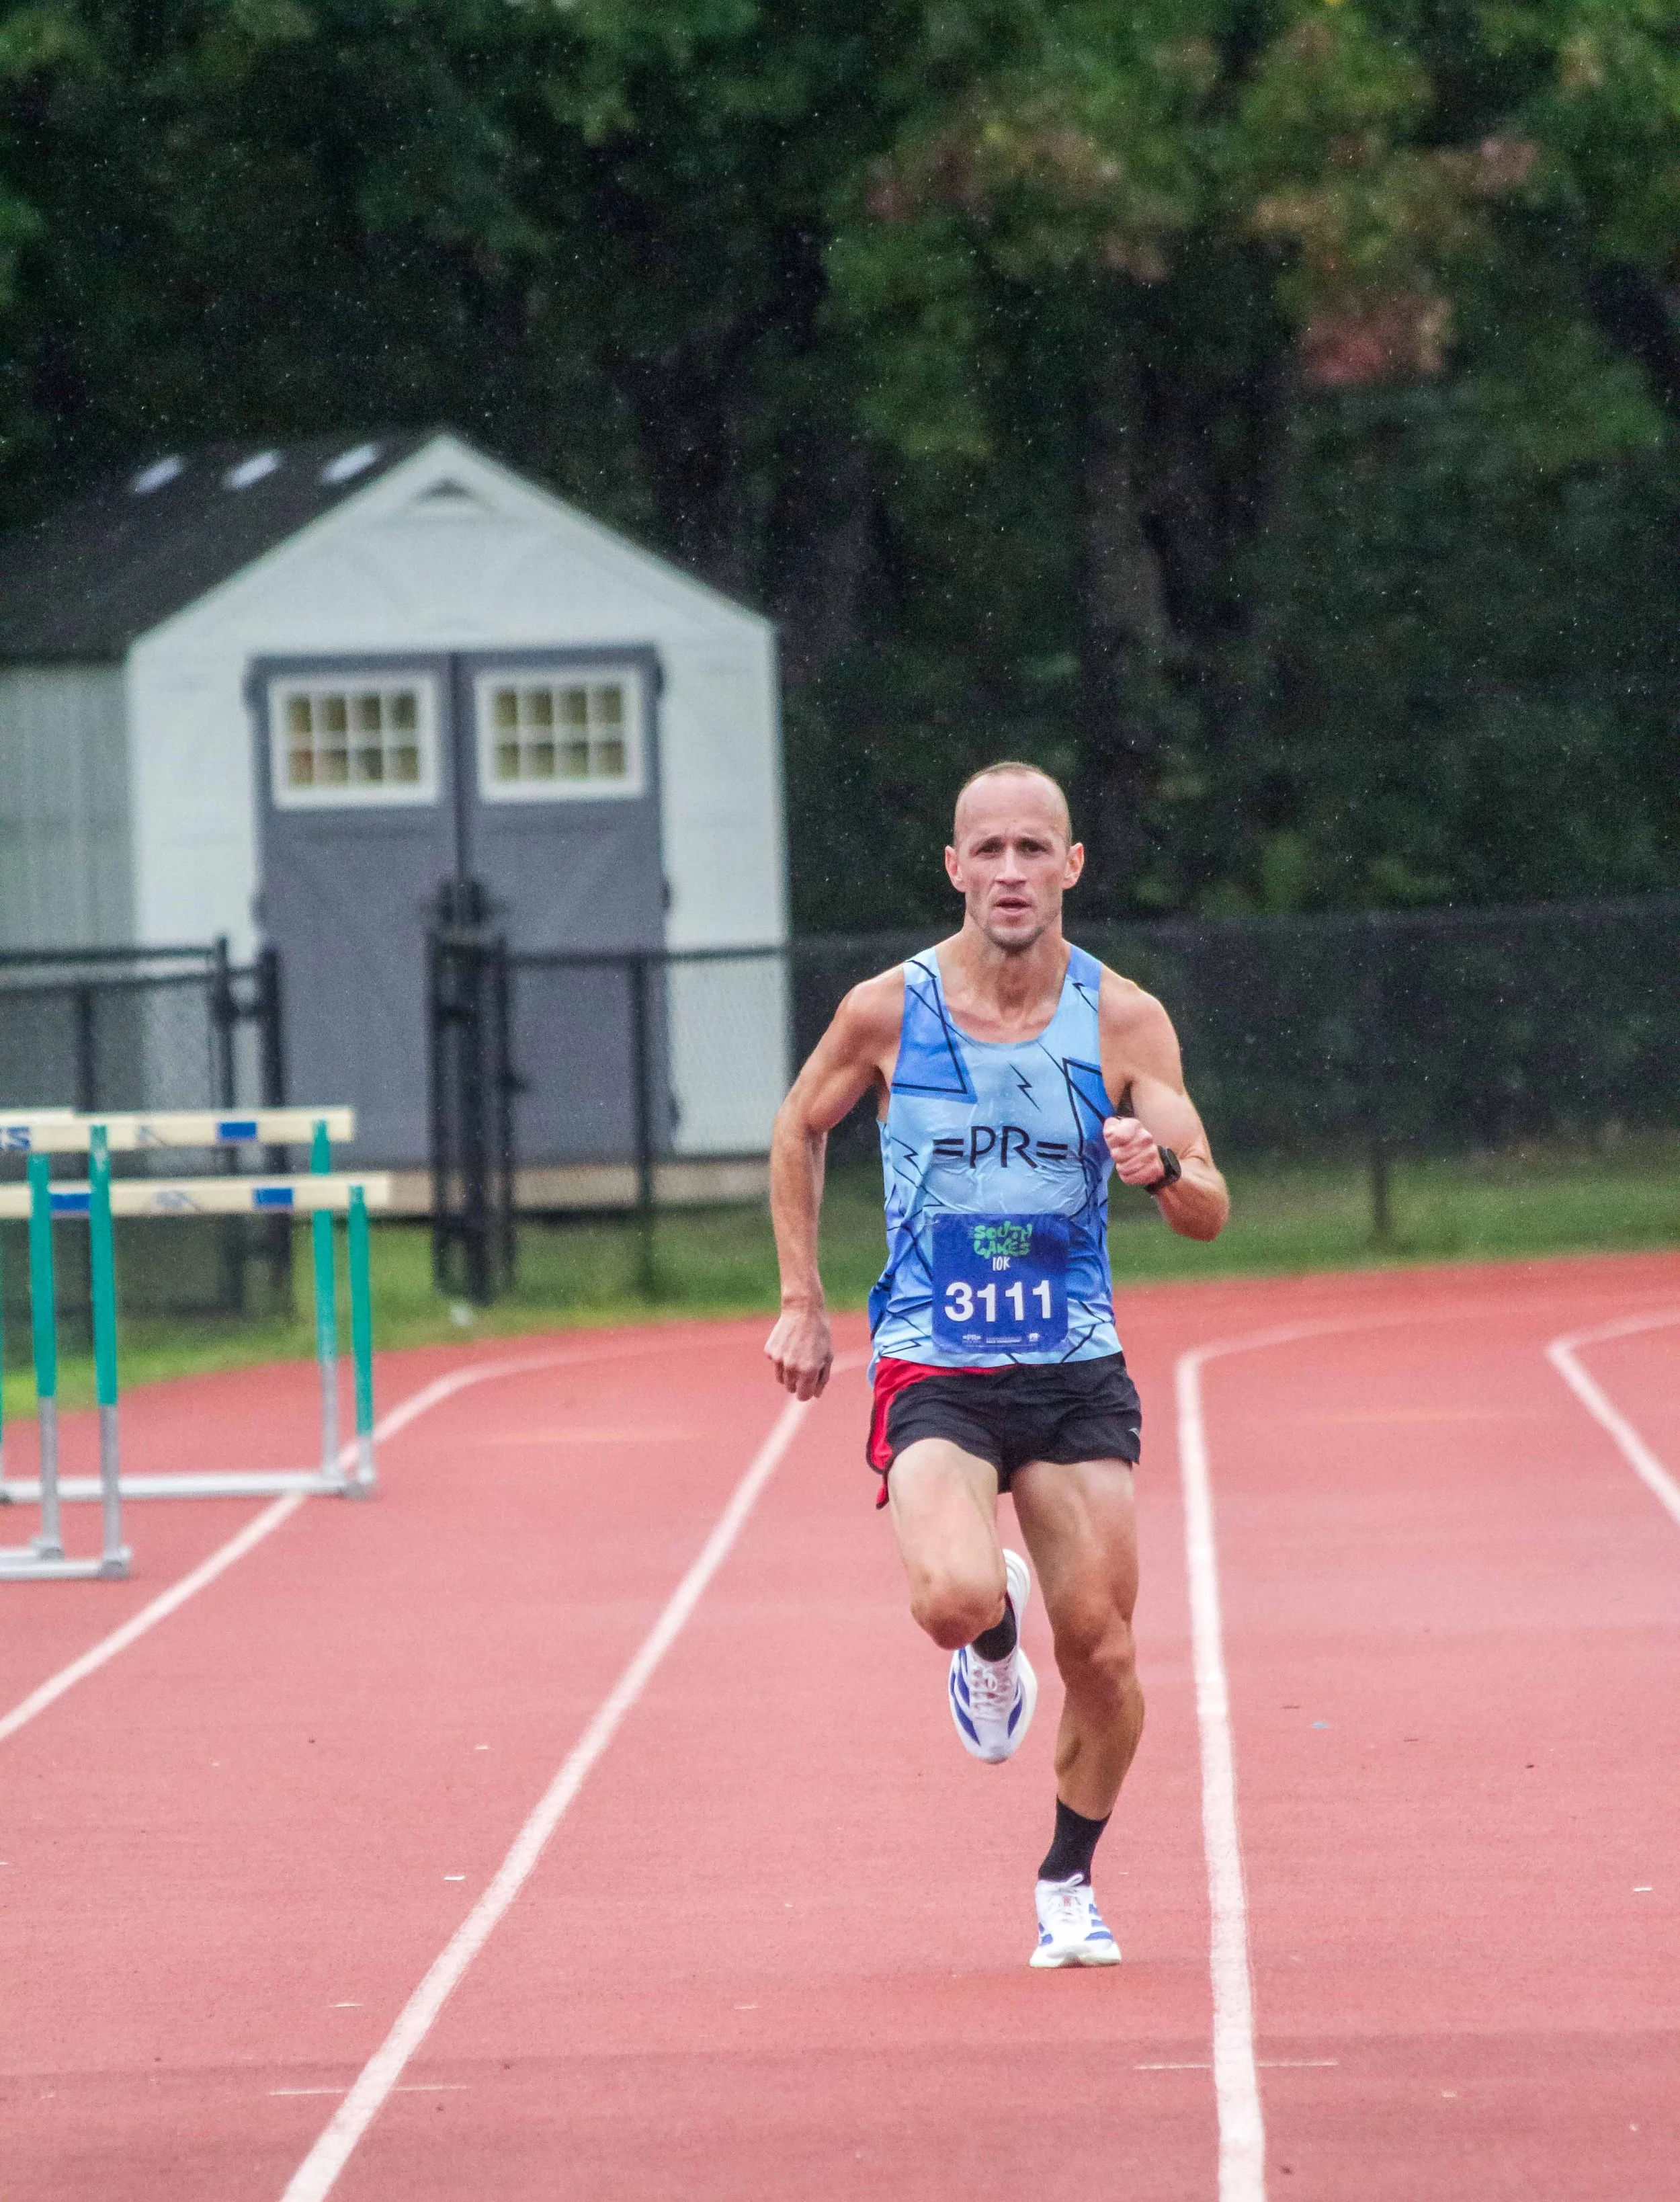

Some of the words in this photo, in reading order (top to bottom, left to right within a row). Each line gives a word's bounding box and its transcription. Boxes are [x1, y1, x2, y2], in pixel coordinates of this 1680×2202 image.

[974, 1221, 1033, 1242] SOUTH
[974, 1238, 1031, 1259] LAKES
[992, 1256, 1011, 1271] 10K
[944, 1280, 1052, 1322] 3111
